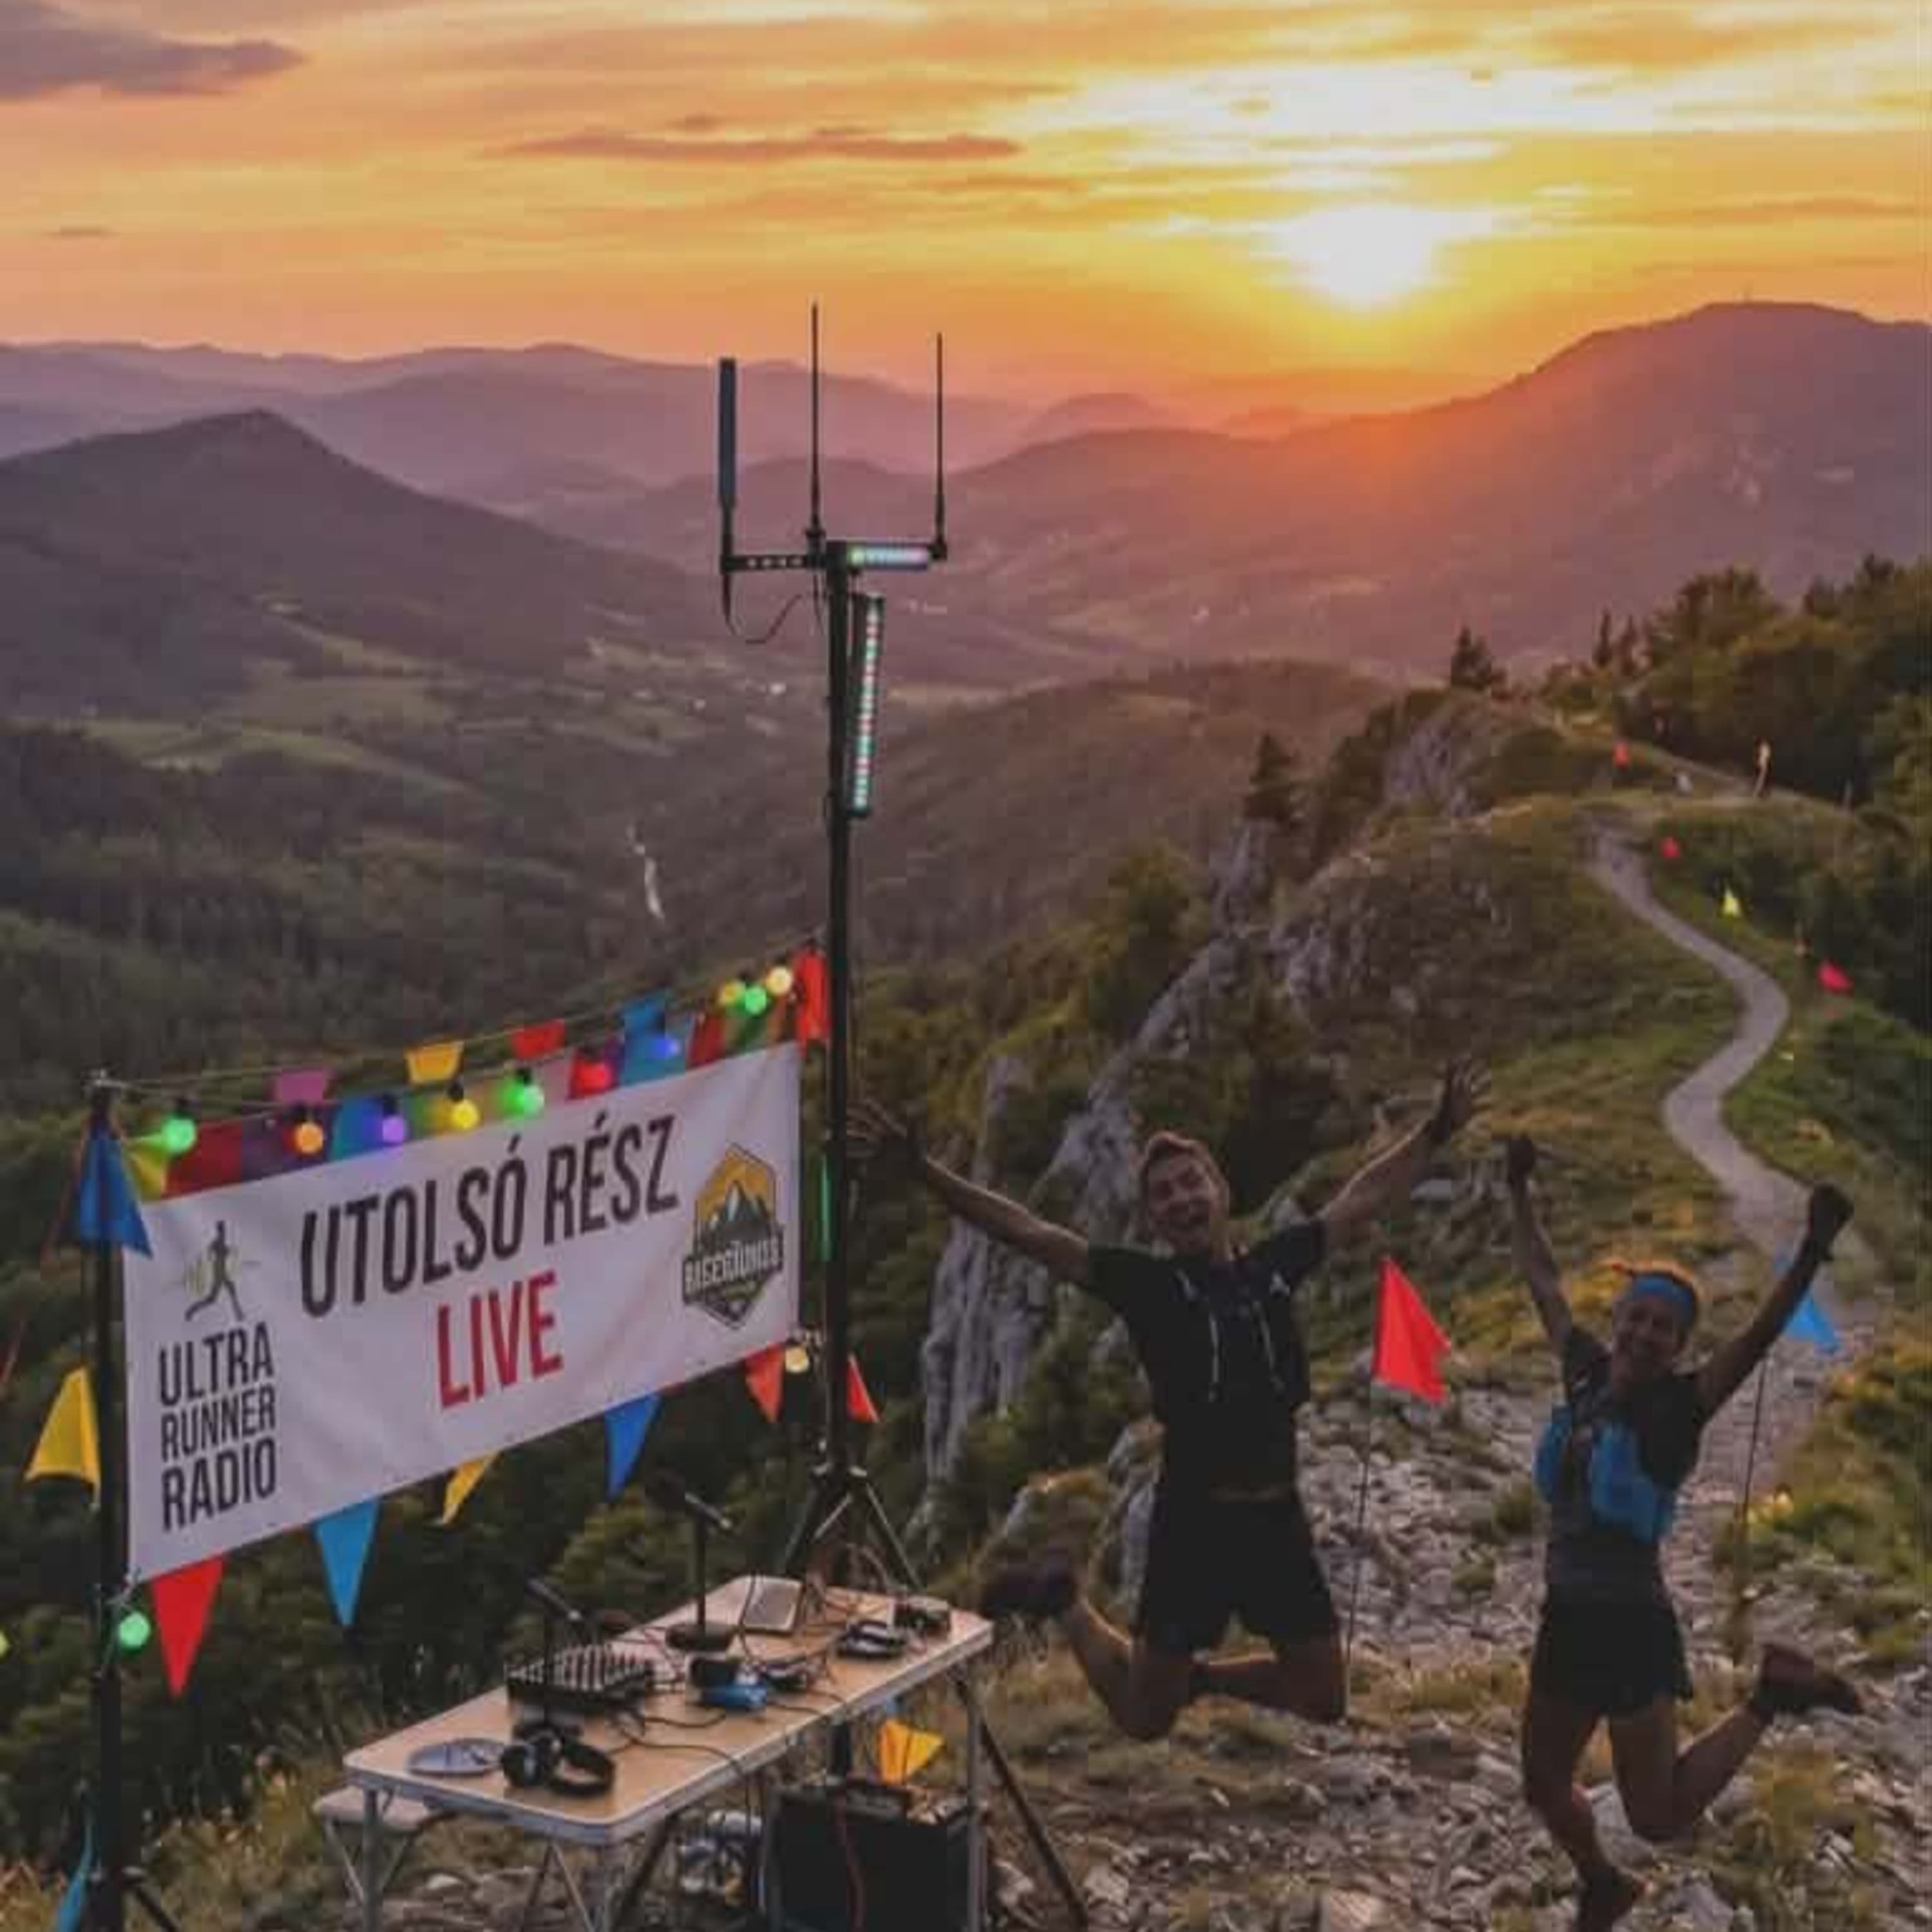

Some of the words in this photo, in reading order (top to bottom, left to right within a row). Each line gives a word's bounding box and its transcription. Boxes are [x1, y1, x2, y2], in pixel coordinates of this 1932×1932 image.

[299, 1133, 529, 1318] UTOLSÓ
[543, 1109, 680, 1247] RÉSZ
[158, 1321, 276, 1408] ULTRA
[437, 1270, 564, 1409] LIVE
[160, 1383, 277, 1463] RUNNER
[160, 1435, 277, 1533] RADIO
